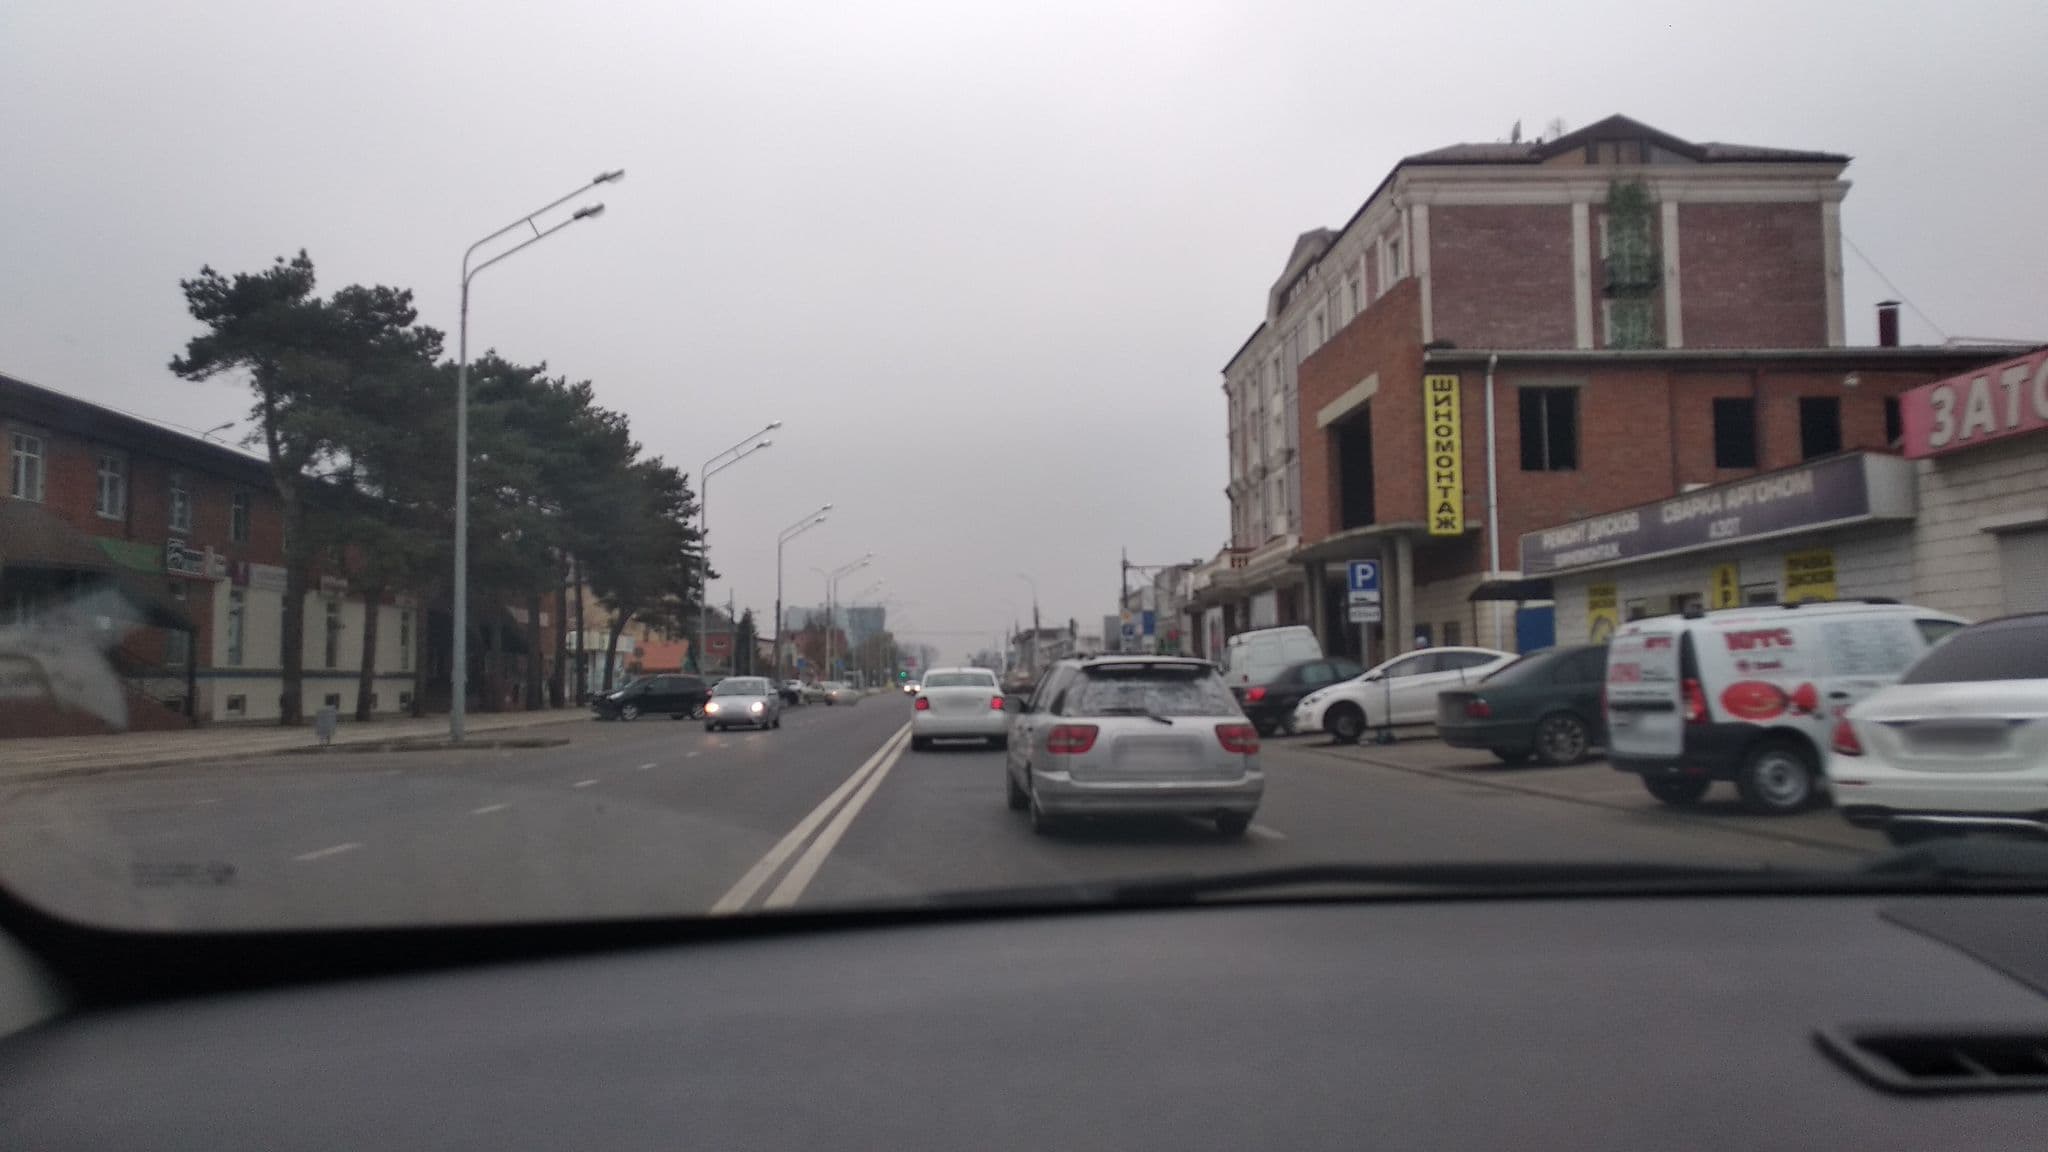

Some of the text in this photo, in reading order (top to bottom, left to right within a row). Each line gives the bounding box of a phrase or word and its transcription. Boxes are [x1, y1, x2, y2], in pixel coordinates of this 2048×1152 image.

[1432, 378, 1457, 530] ШИНОМОНТАЖ
[1662, 470, 1813, 524] СВАРКА АРГОНОМ
[1542, 512, 1640, 550] РЕМОНТ ДИСКОВ
[1355, 564, 1374, 588] P
